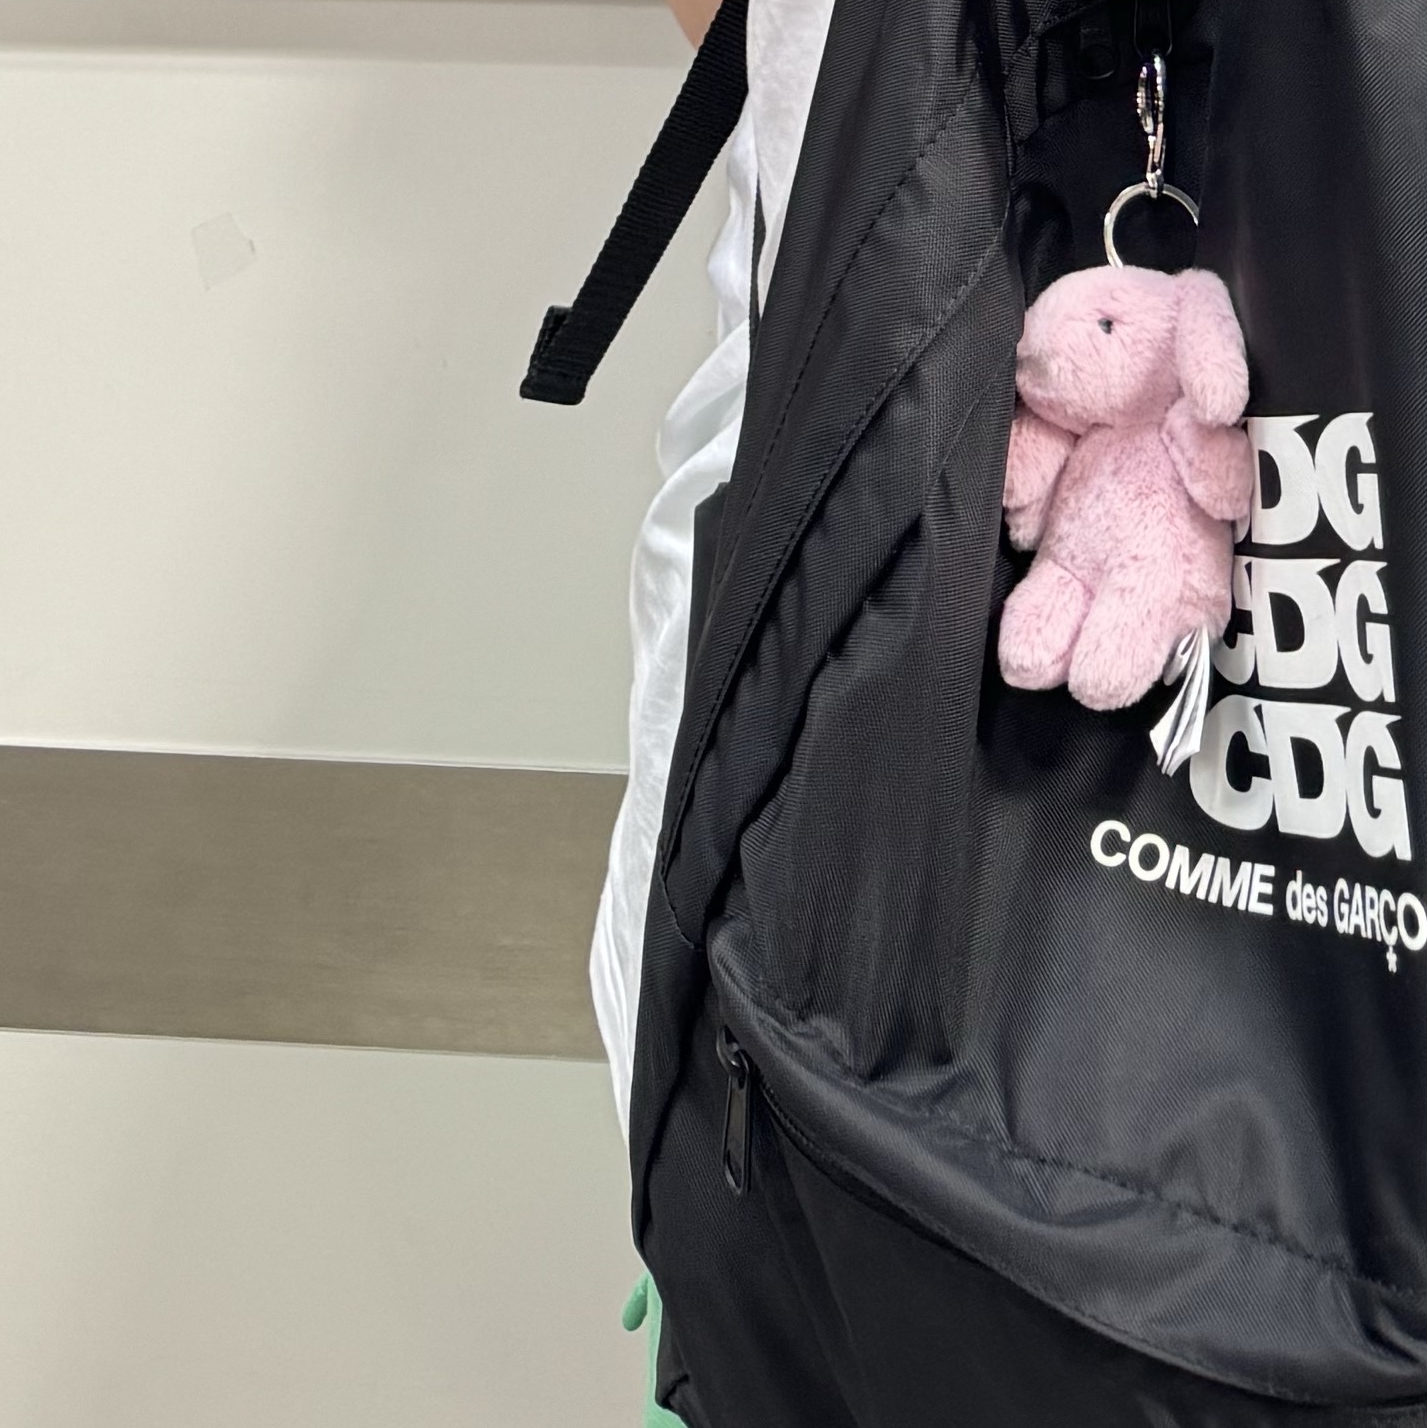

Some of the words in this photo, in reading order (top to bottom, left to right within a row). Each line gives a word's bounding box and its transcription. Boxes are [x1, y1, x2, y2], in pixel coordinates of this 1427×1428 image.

[1235, 412, 1384, 551] DG
[1188, 694, 1412, 862] CDG
[1089, 819, 1275, 916] COMME
[1285, 870, 1329, 928] des
